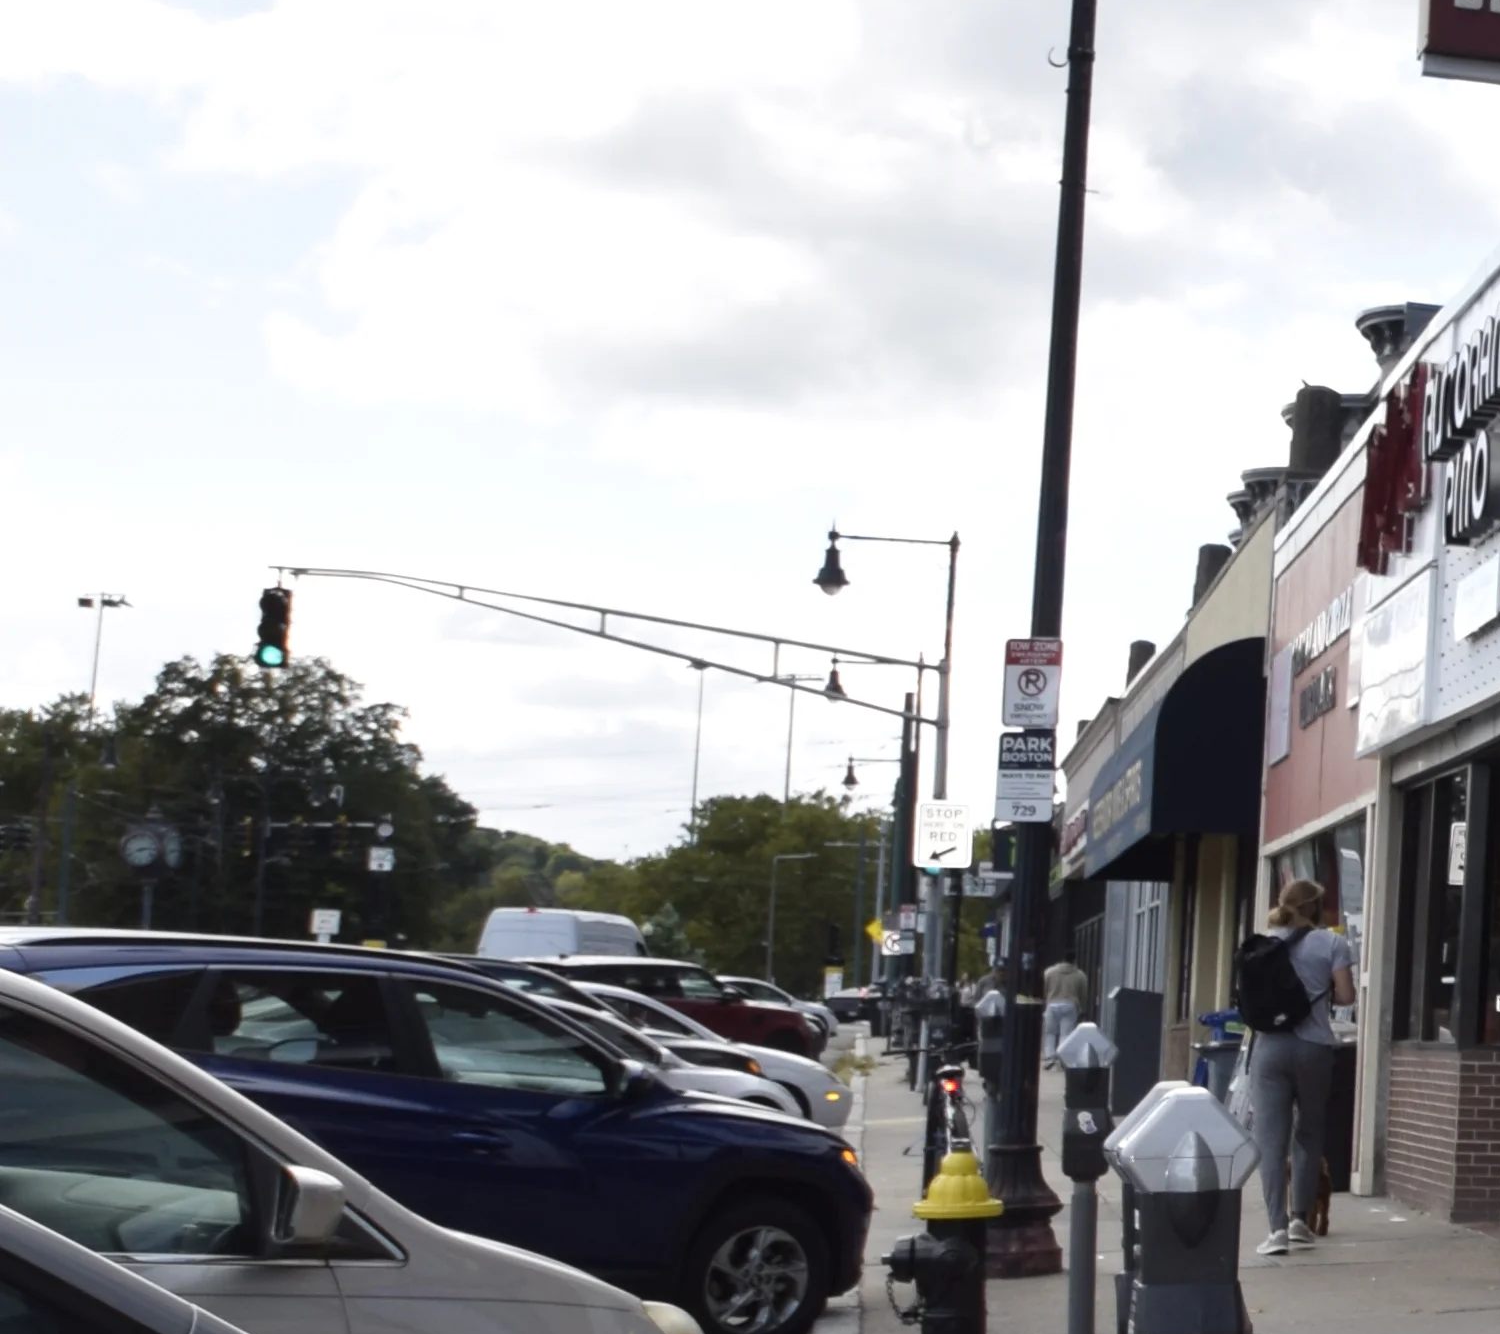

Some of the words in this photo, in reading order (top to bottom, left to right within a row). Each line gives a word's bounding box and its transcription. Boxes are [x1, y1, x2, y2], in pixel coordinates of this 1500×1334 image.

[1442, 429, 1490, 545] PINO
[1010, 641, 1031, 652] TOW
[1034, 641, 1060, 653] ZONE
[1012, 702, 1045, 713] SNOW
[1002, 737, 1053, 752] PARK
[1002, 751, 1053, 763] BOSTON
[926, 808, 964, 819] STOP
[1011, 804, 1037, 817] 729
[929, 831, 958, 842] RED
